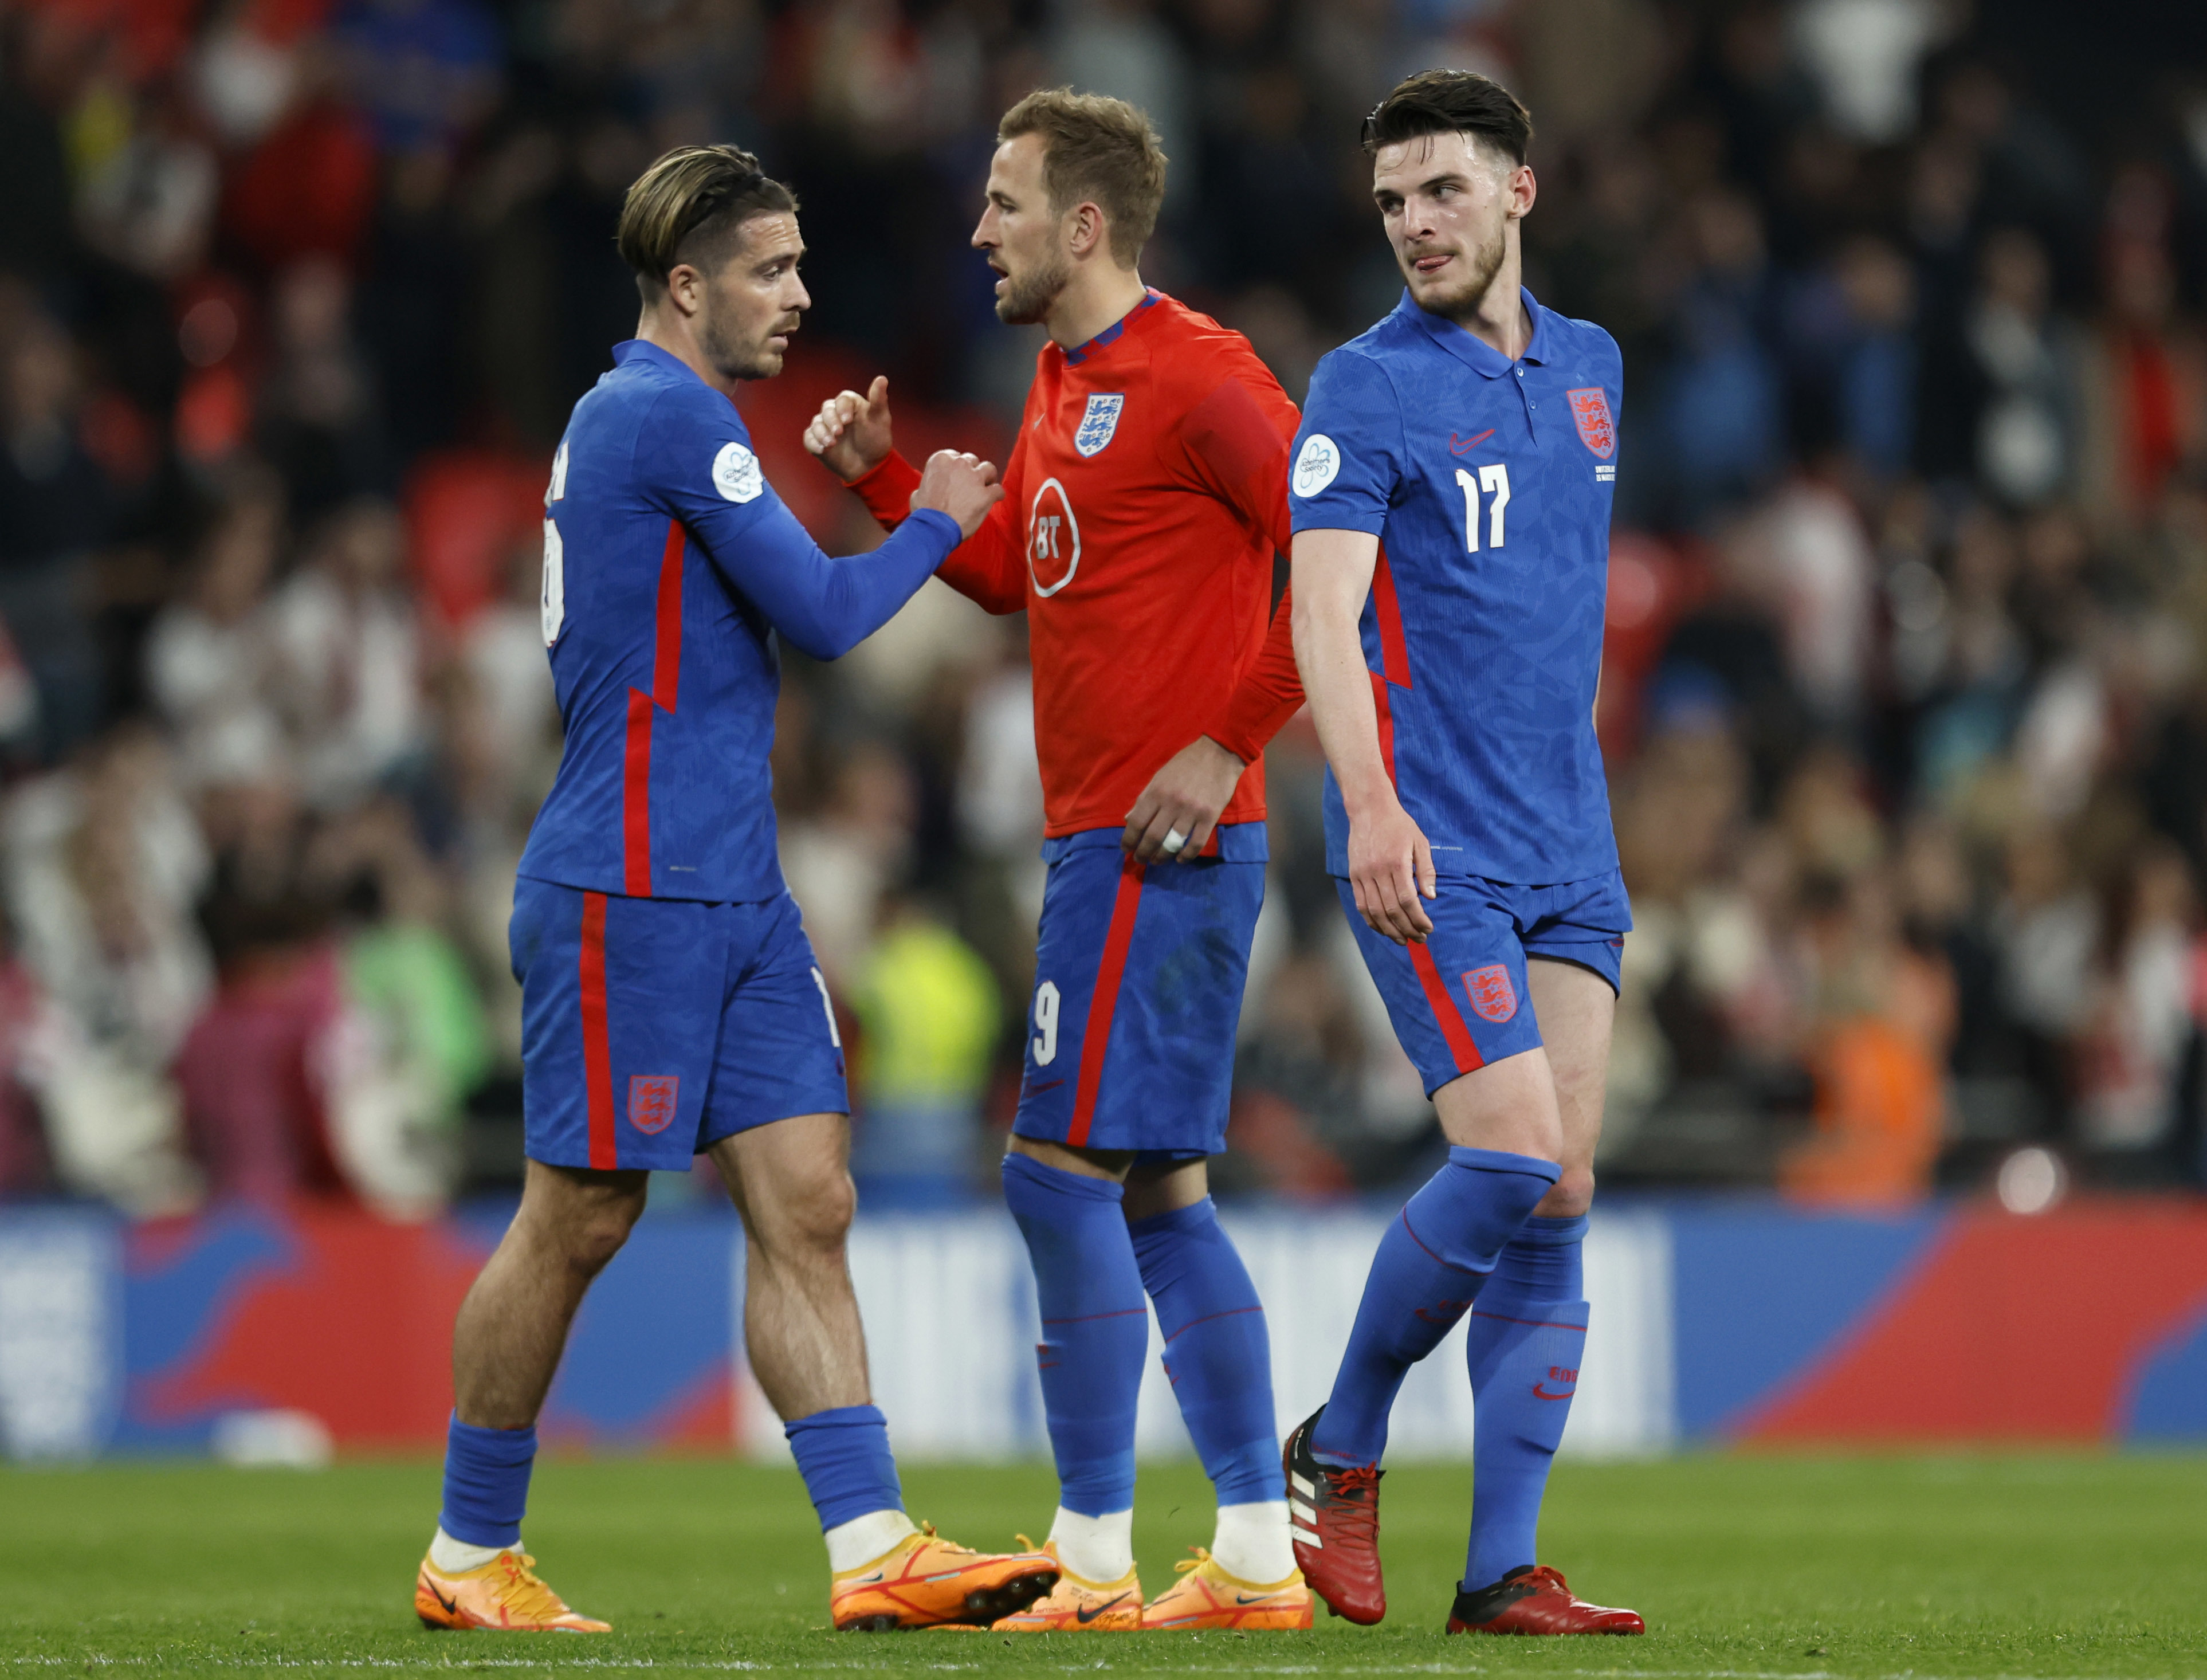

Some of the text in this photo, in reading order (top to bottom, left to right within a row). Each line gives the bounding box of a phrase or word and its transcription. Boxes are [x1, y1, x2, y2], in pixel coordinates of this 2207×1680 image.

[1036, 516, 1061, 559] BT
[1455, 464, 1511, 554] 17
[1033, 980, 1061, 1067] 9
